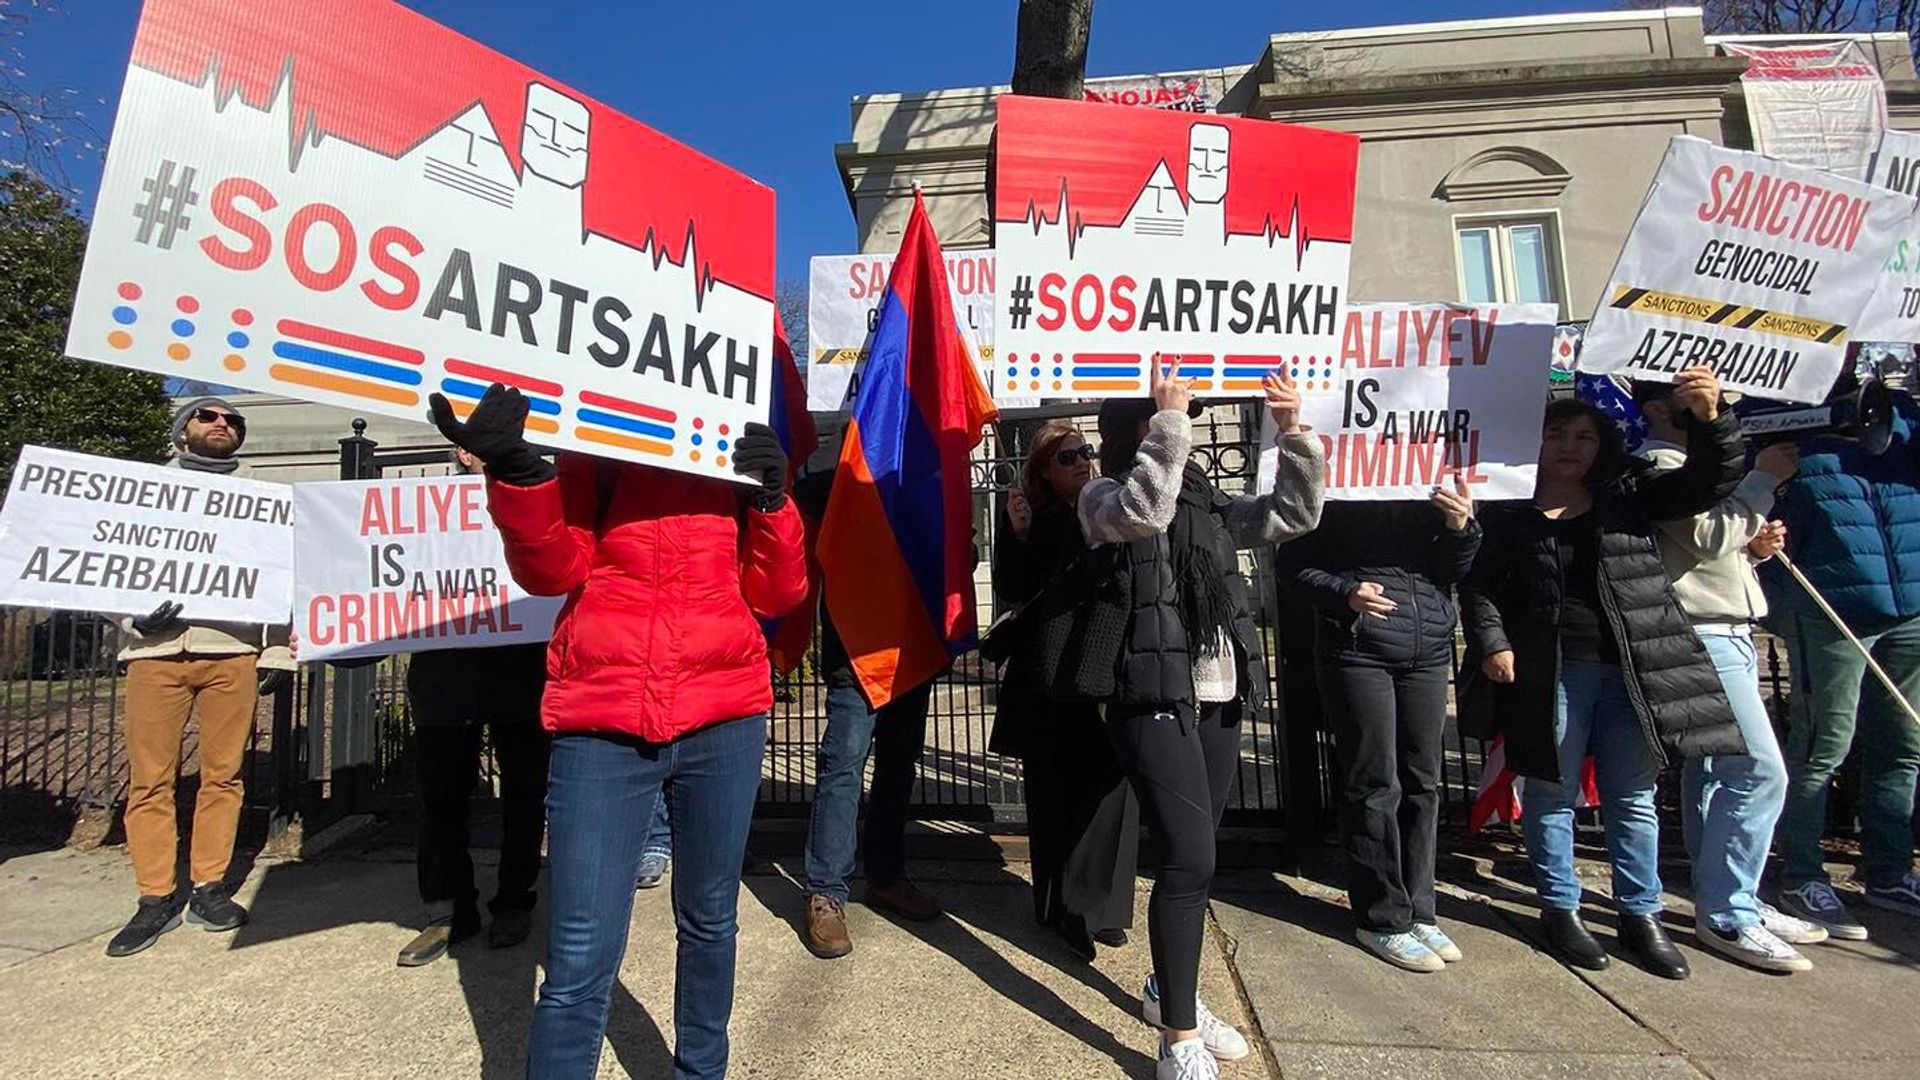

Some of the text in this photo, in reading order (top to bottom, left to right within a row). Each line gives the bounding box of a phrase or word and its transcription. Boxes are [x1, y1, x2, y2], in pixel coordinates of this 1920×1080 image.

[1697, 165, 1872, 252] SANCTION
[133, 158, 758, 406] #SOSARTSAKH
[1694, 238, 1819, 295] GENOCIDAL
[1009, 272, 1338, 336] #SOSARTSAKH
[1643, 294, 1821, 337] SANCTIONS SANCTIONS
[1339, 308, 1499, 369] ALIYEV
[1627, 328, 1799, 391] AZERBAIJAN
[1342, 378, 1471, 445] IS A WAR
[19, 463, 199, 513] PRESIDENT
[1321, 429, 1489, 488] RIMINAL
[92, 520, 217, 553] SANCTION
[359, 483, 483, 536] ALIYE
[20, 546, 259, 599] AZERBAIJAN
[370, 543, 497, 601] IS A WAR
[308, 584, 523, 646] CRIMINAL
